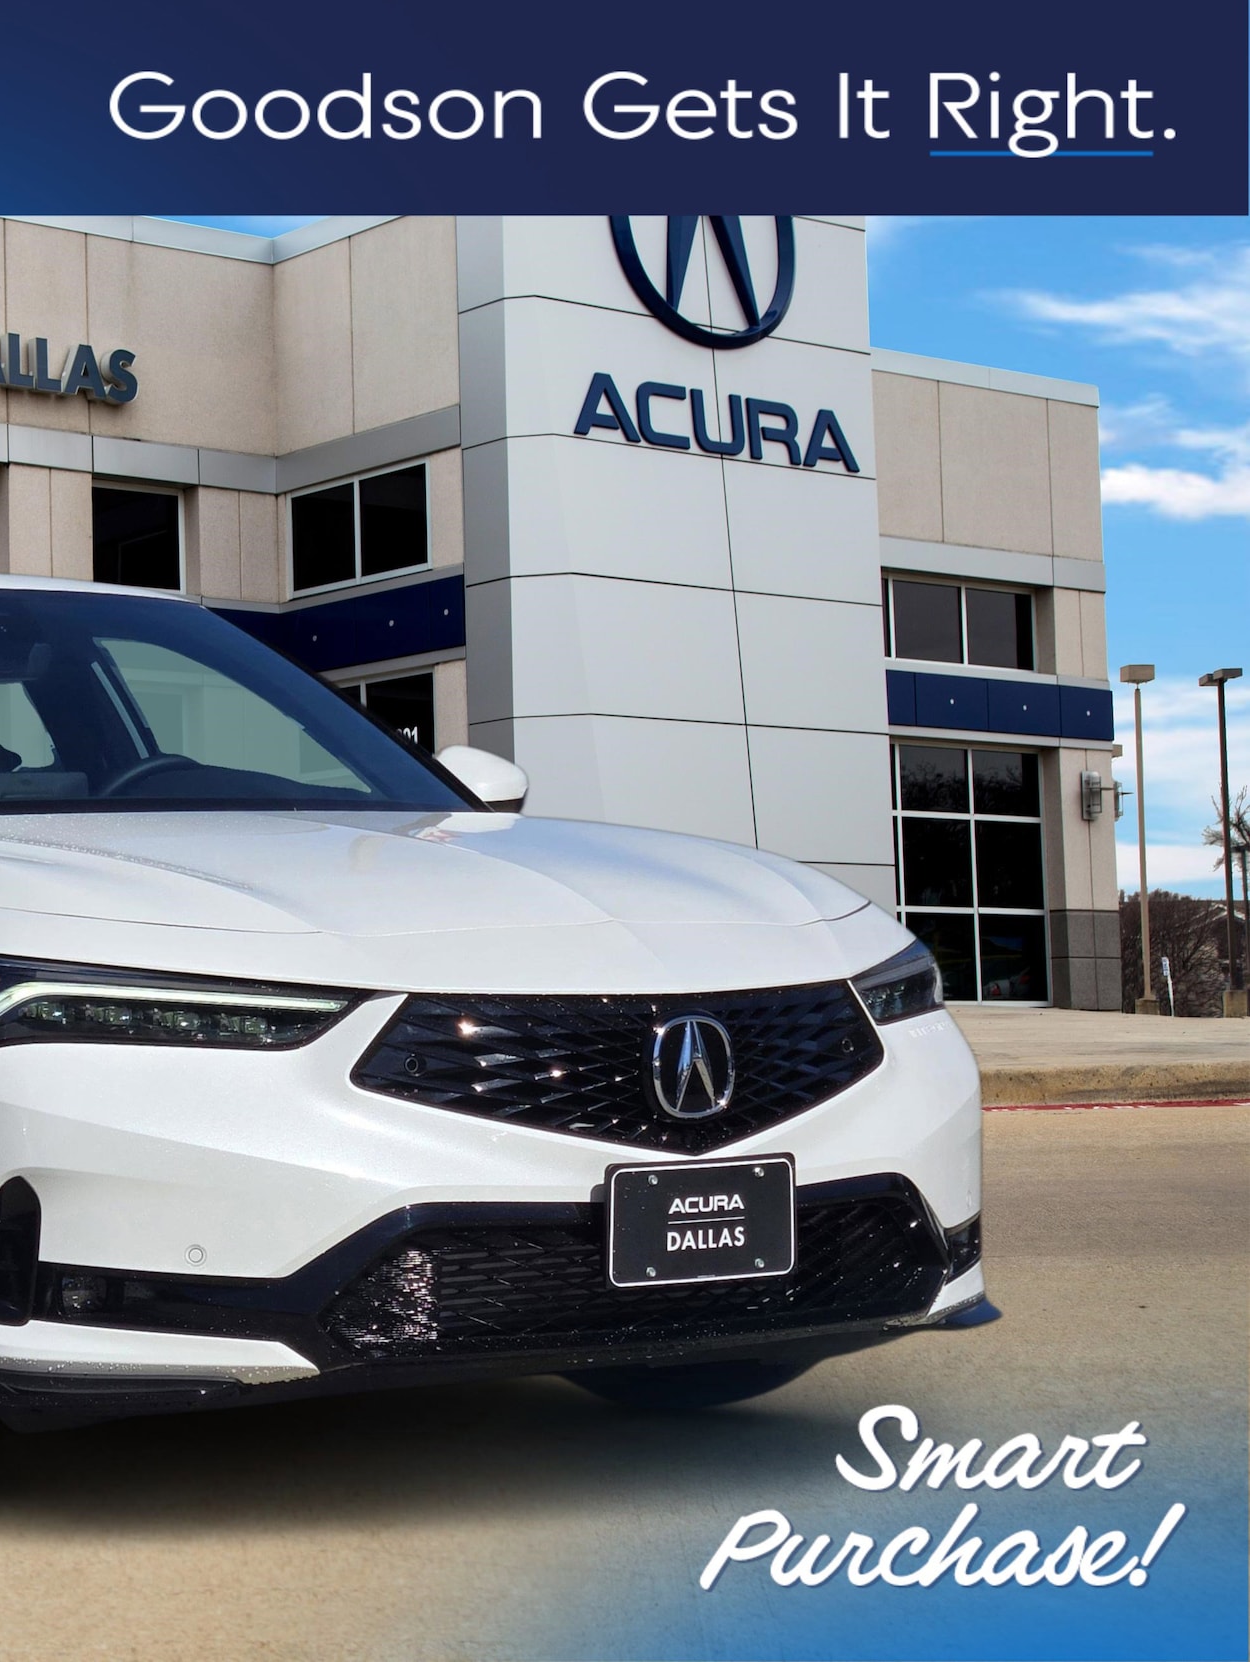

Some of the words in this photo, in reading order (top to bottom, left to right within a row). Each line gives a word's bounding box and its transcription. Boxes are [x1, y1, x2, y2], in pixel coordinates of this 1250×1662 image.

[573, 372, 861, 474] ACURA
[668, 1193, 746, 1215] ACURA
[666, 1225, 746, 1252] DALLAS
